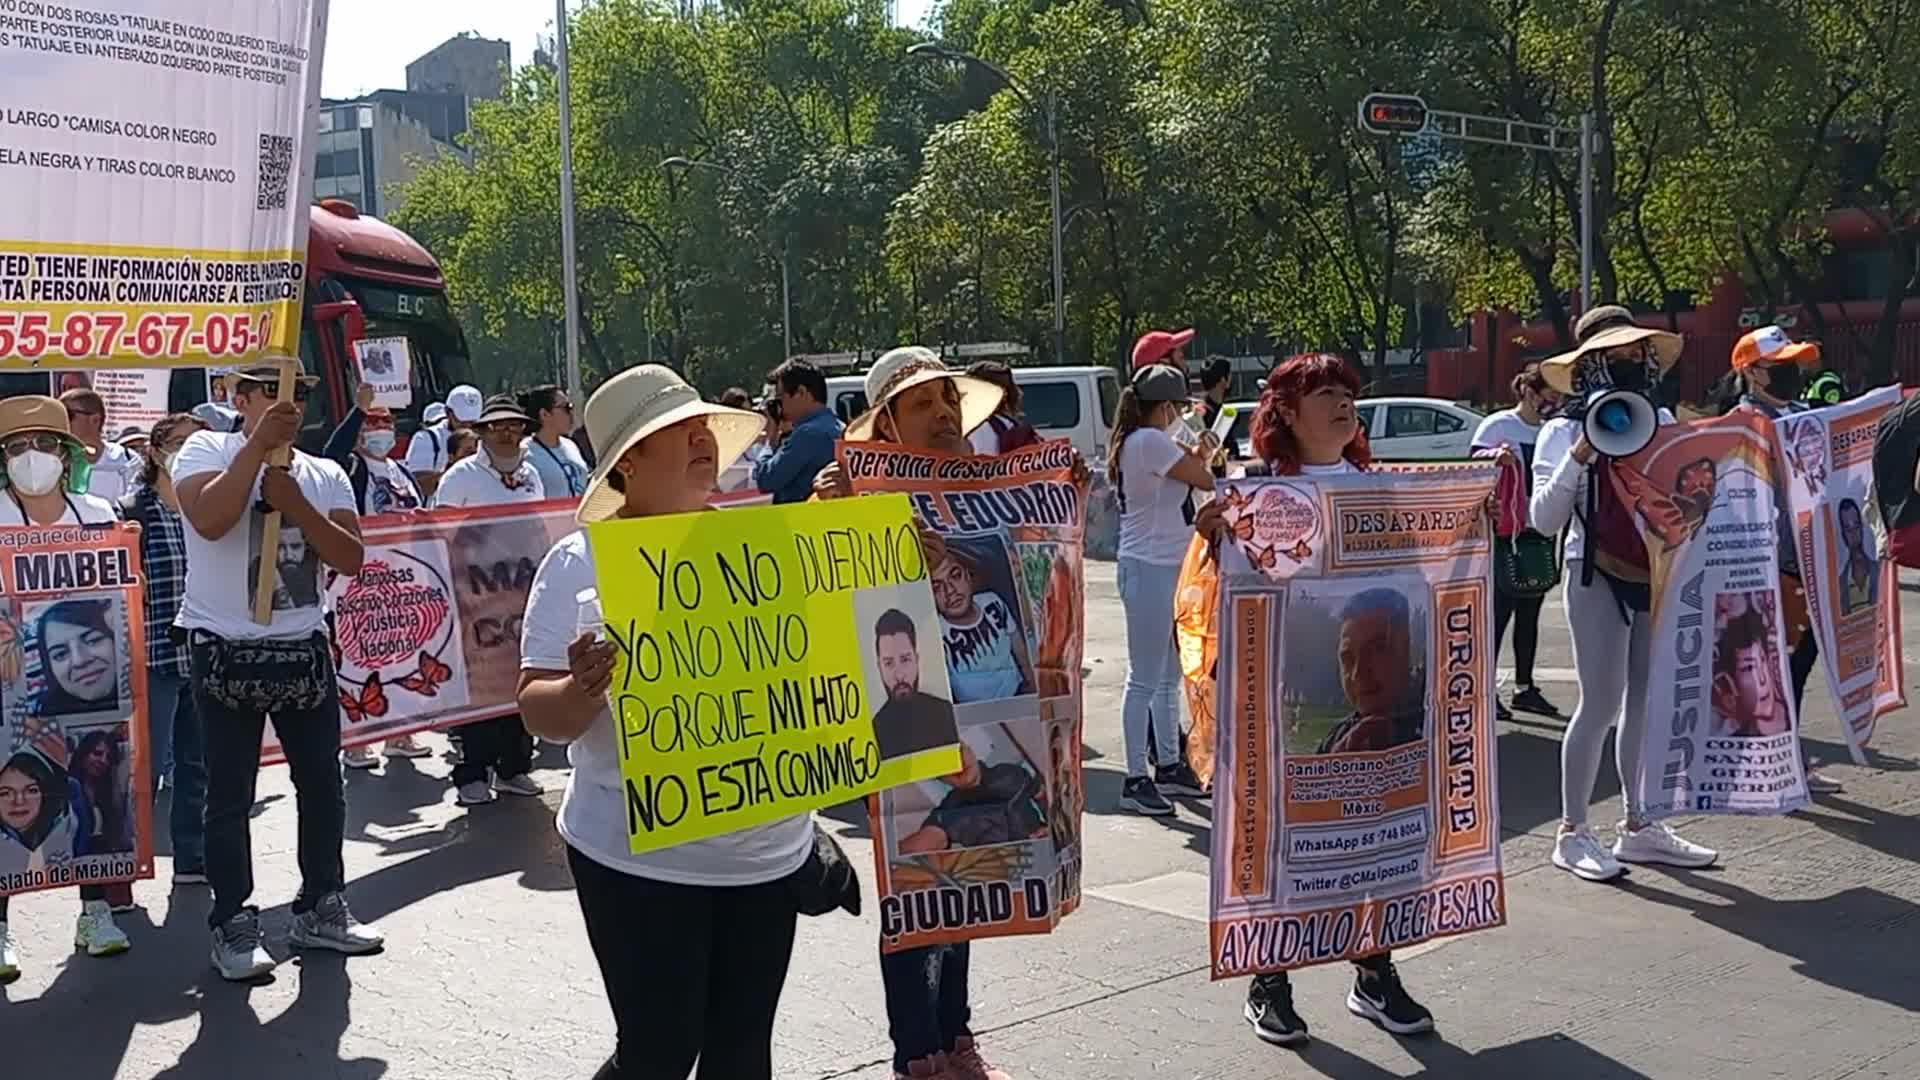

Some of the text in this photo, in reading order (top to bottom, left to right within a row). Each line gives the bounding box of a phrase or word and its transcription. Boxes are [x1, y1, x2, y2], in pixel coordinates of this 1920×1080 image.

[0, 15, 38, 33] PARTE
[40, 21, 114, 42] POSTERIOR
[117, 30, 140, 45] UNA
[141, 34, 172, 50] ABEJA
[174, 39, 195, 54] CON
[196, 43, 209, 57] UN
[250, 53, 269, 67] CON
[19, 1, 44, 16] CON
[47, 5, 73, 21] DOS
[75, 10, 119, 26] ROSAS
[173, 22, 187, 37] EN
[188, 26, 215, 42] CODO
[216, 31, 264, 51] IZQUIERDO
[74, 41, 93, 55] EN
[95, 43, 159, 65] ANTEBRAZO
[161, 53, 211, 73] IZQUIERDO
[213, 62, 241, 78] PARTE
[244, 66, 287, 86] POSTERIOR
[7, 108, 60, 129] LARGO
[124, 122, 170, 141] COLOR
[172, 127, 217, 146] NEGRO
[30, 151, 82, 171] NEGRA
[83, 155, 94, 171] Y
[97, 157, 137, 175] TIRAS
[139, 161, 185, 179] COLOR
[187, 166, 236, 184] BLANCO
[35, 255, 87, 278] TIENE
[92, 256, 201, 281] INFORMACIÓN
[205, 262, 249, 282] SOBRE
[0, 279, 25, 301] TA
[31, 280, 110, 301] PERSONA
[116, 281, 226, 303] COMUNICARSE
[228, 284, 239, 303] A
[243, 284, 263, 303] ESTE
[944, 482, 1078, 533] EDUARDO
[0, 528, 105, 550] aparecida
[14, 549, 137, 591] MABEL
[639, 545, 701, 611] YO
[716, 543, 781, 607] NO
[364, 609, 418, 633] Justicia
[359, 633, 419, 658] Nacional
[605, 613, 809, 690] YO NO VIVO
[1662, 569, 1705, 793] JUSTICIA
[618, 688, 767, 760] PORQUE
[767, 678, 808, 735] MI
[1446, 604, 1477, 832] URGENTE
[624, 773, 689, 836] NO
[775, 736, 881, 799] CONMIGO
[1287, 761, 1330, 777] Daniel
[1332, 759, 1384, 774] Soriano
[1294, 838, 1359, 853] WhatsApp
[1361, 833, 1375, 846] 55
[49, 865, 71, 885] de
[75, 858, 134, 880] México
[1293, 877, 1337, 893] Twitter
[880, 882, 1012, 936] CIUDAD
[1023, 877, 1049, 920] D
[1219, 879, 1498, 971] AYUDALO A REGRESAR
